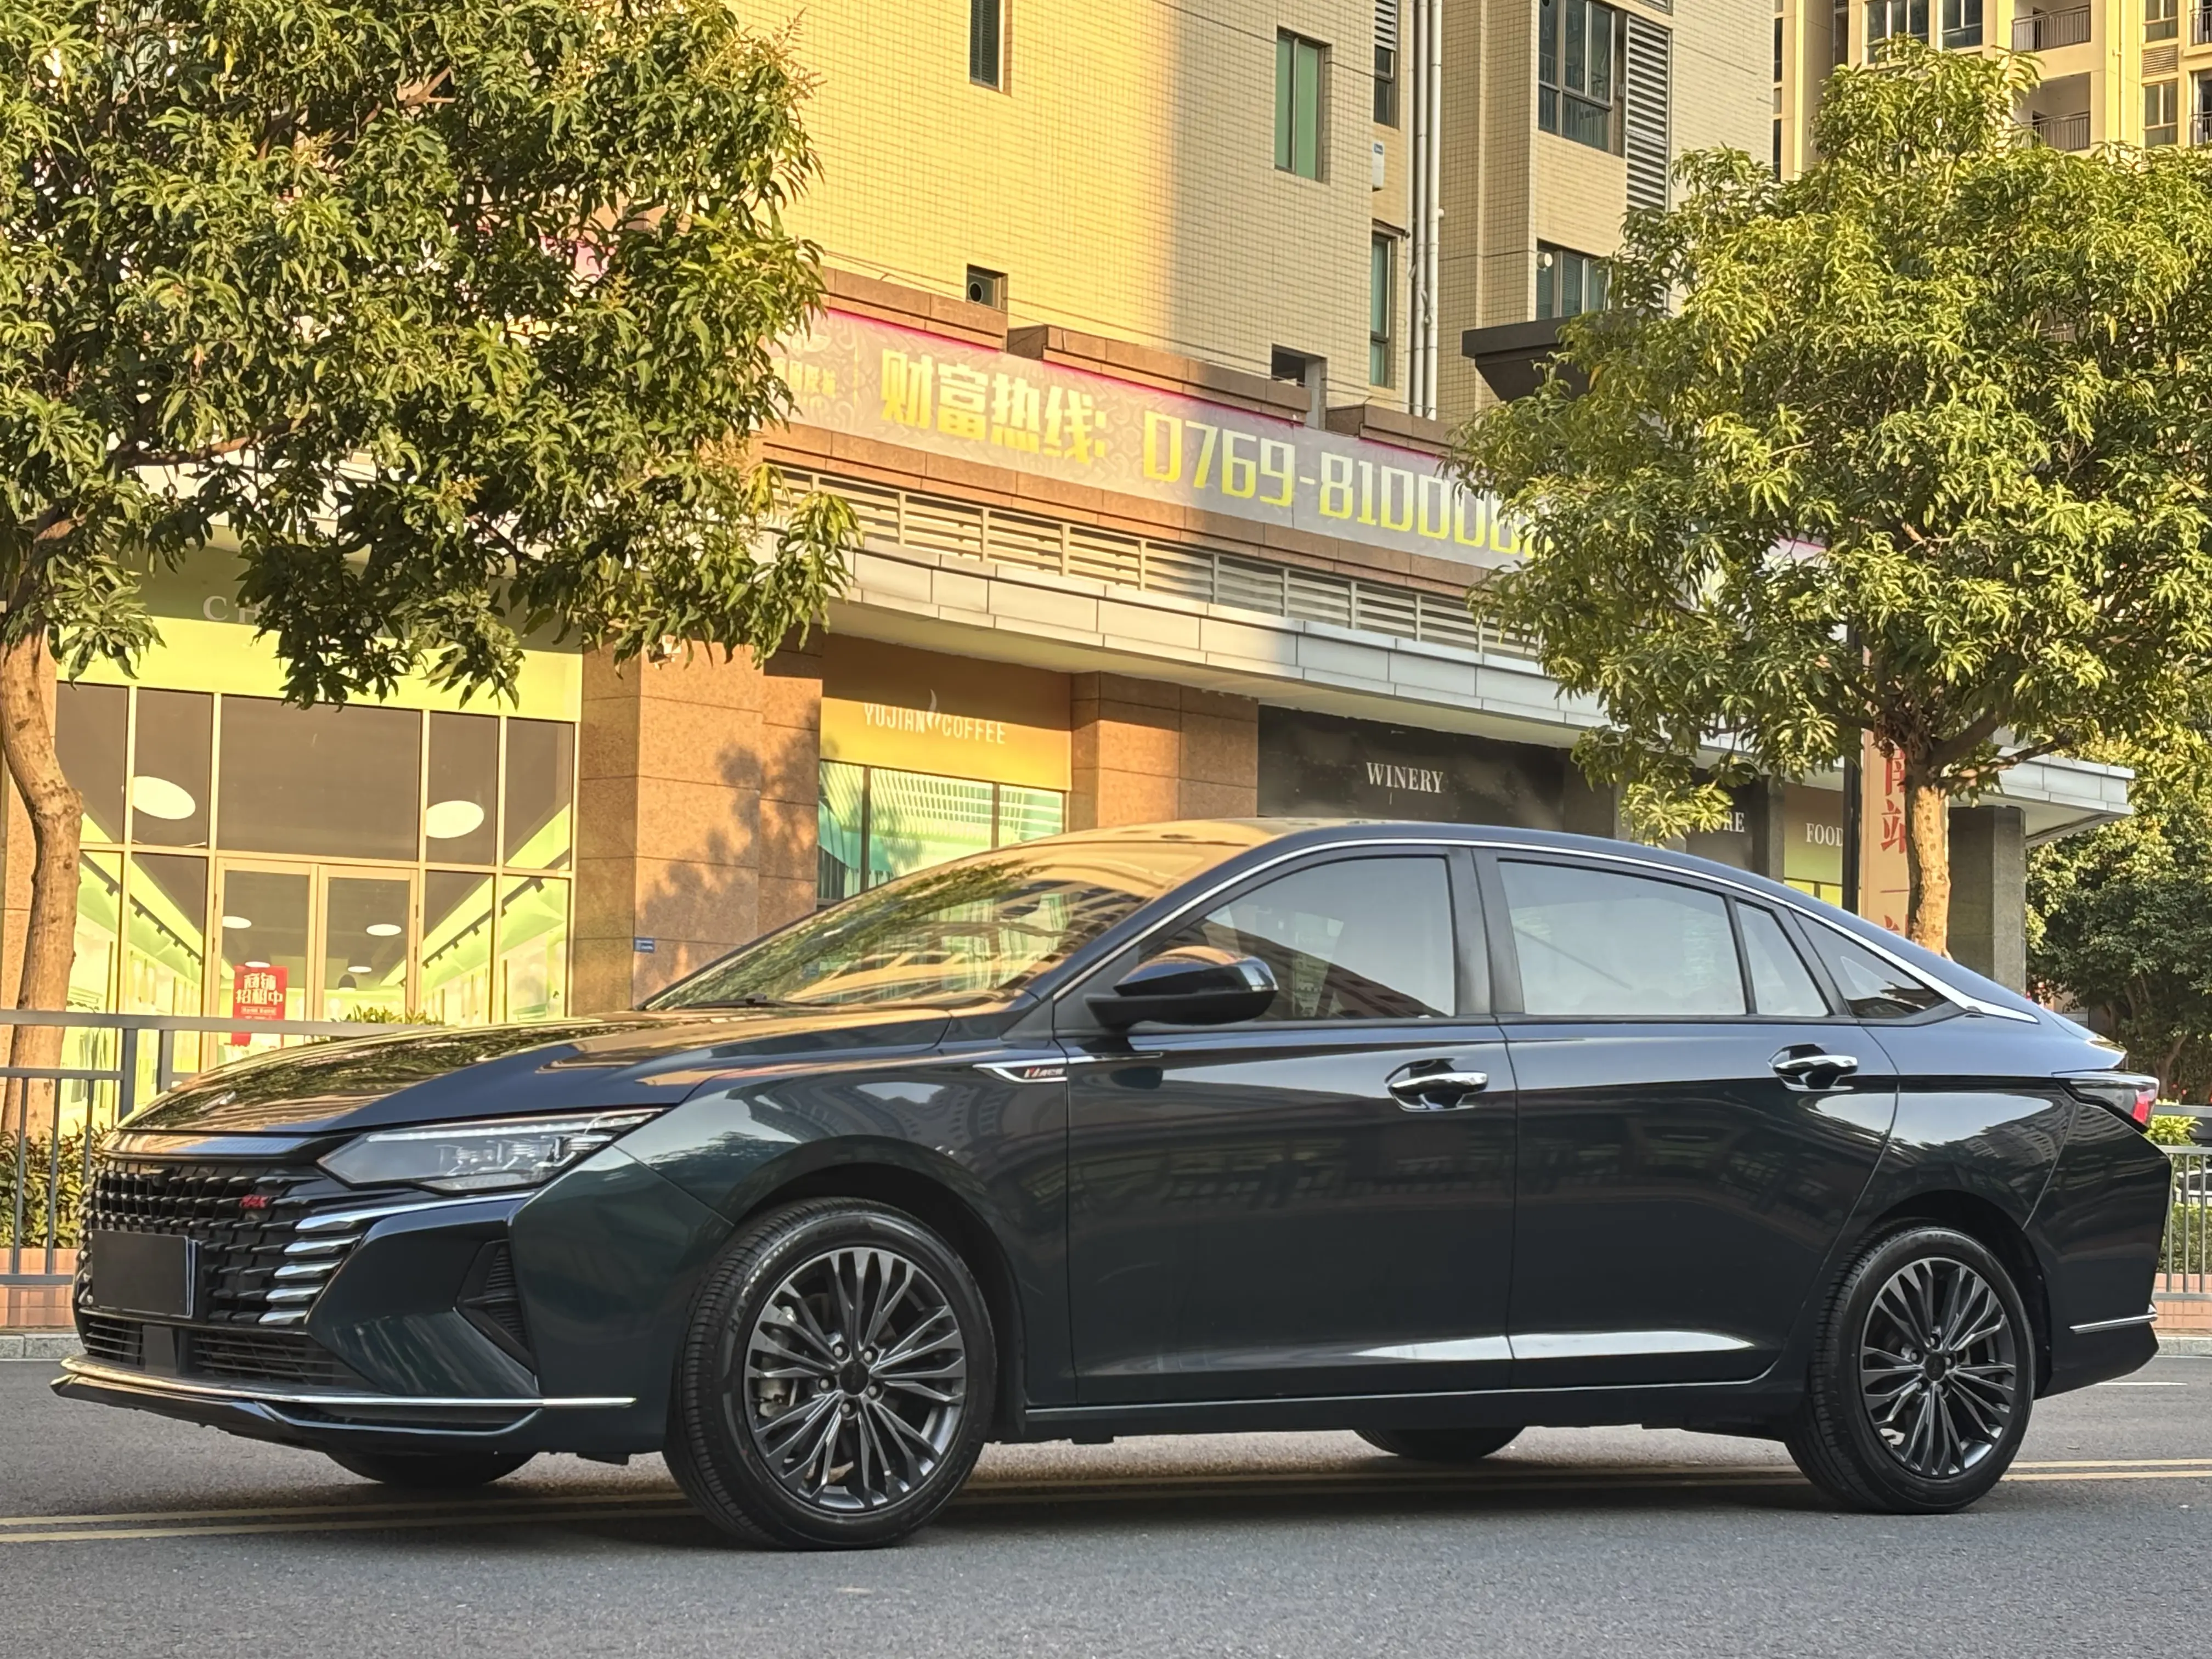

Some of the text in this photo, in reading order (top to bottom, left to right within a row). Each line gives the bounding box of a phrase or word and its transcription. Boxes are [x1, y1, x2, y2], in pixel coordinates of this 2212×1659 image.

[864, 702, 1006, 744] YUJIAN COFFEE
[1366, 762, 1444, 793] WINERY
[236, 989, 284, 1005] 招租中
